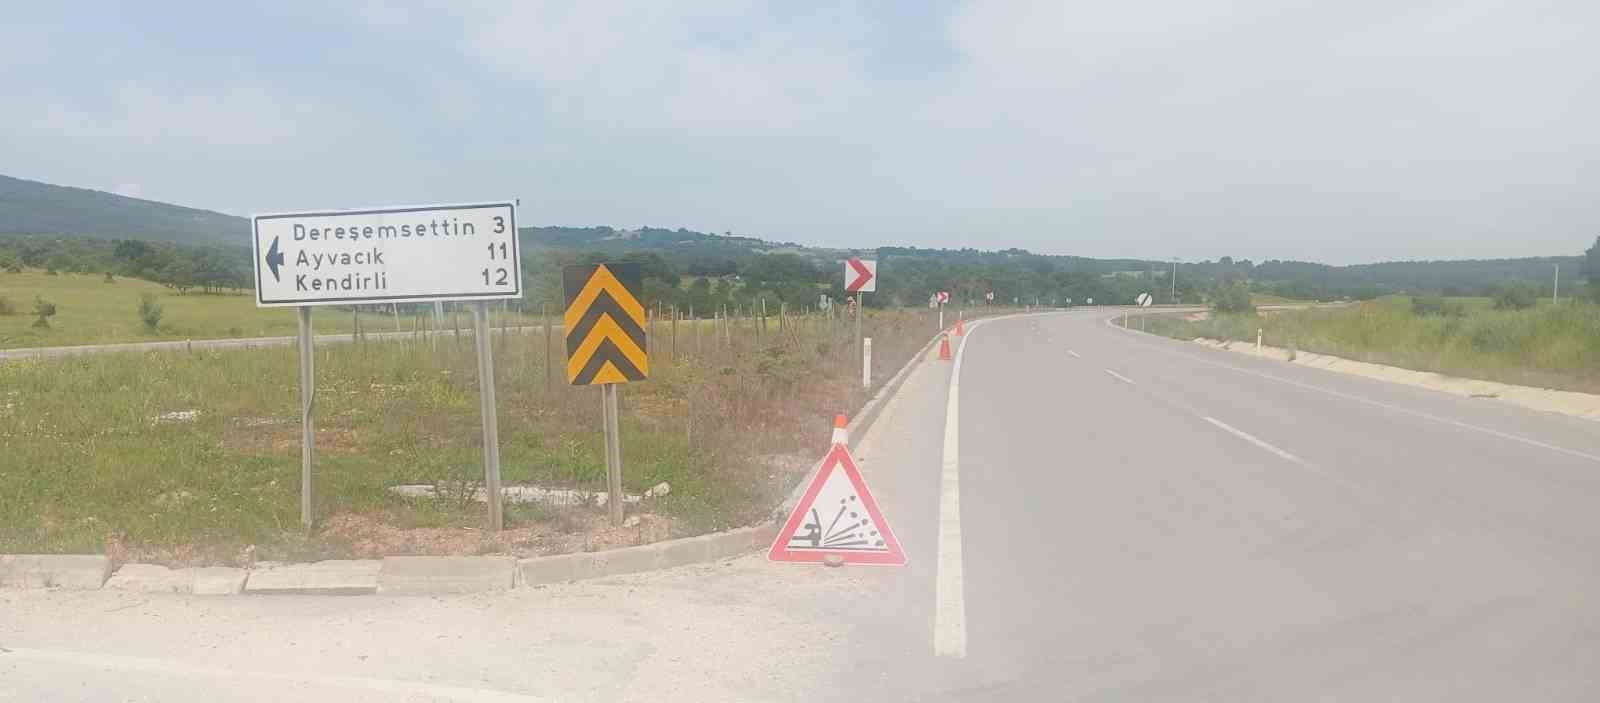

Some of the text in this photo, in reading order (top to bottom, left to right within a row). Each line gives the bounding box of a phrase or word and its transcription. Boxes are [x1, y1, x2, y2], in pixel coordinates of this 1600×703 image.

[293, 216, 505, 241] Dereşemsettin 3
[295, 242, 507, 271] Ayvacık 11
[295, 268, 508, 292] Kendirli 12
